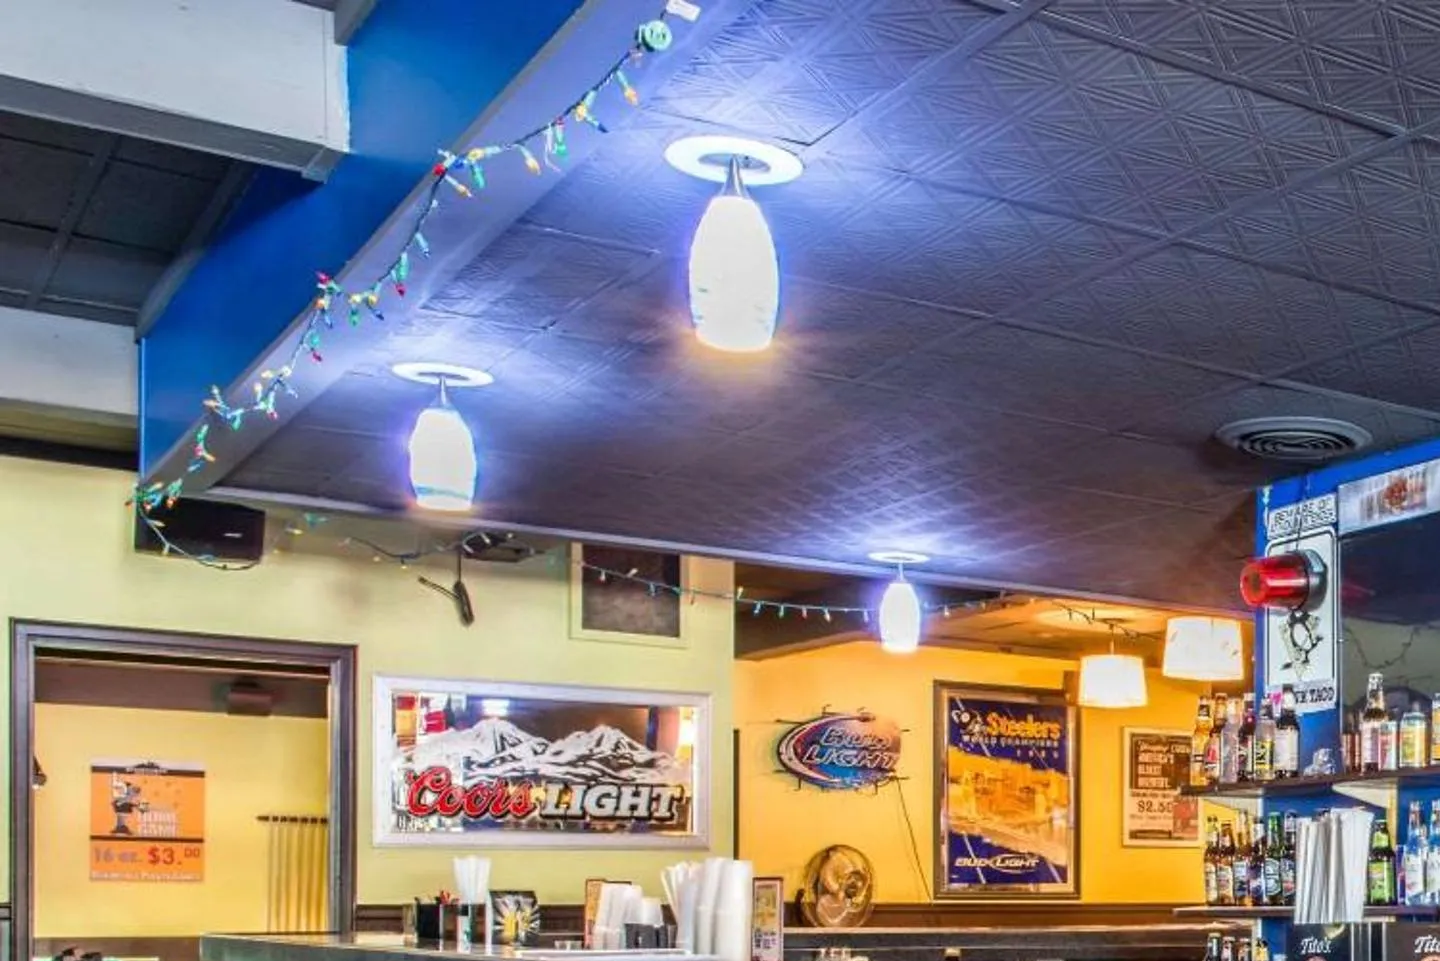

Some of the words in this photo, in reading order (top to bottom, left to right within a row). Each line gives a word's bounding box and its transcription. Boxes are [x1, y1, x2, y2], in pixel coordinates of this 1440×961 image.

[986, 711, 1061, 740] Steelers
[407, 766, 535, 819] Coors
[542, 782, 684, 820] LIGHT
[1300, 936, 1332, 955] Tito's
